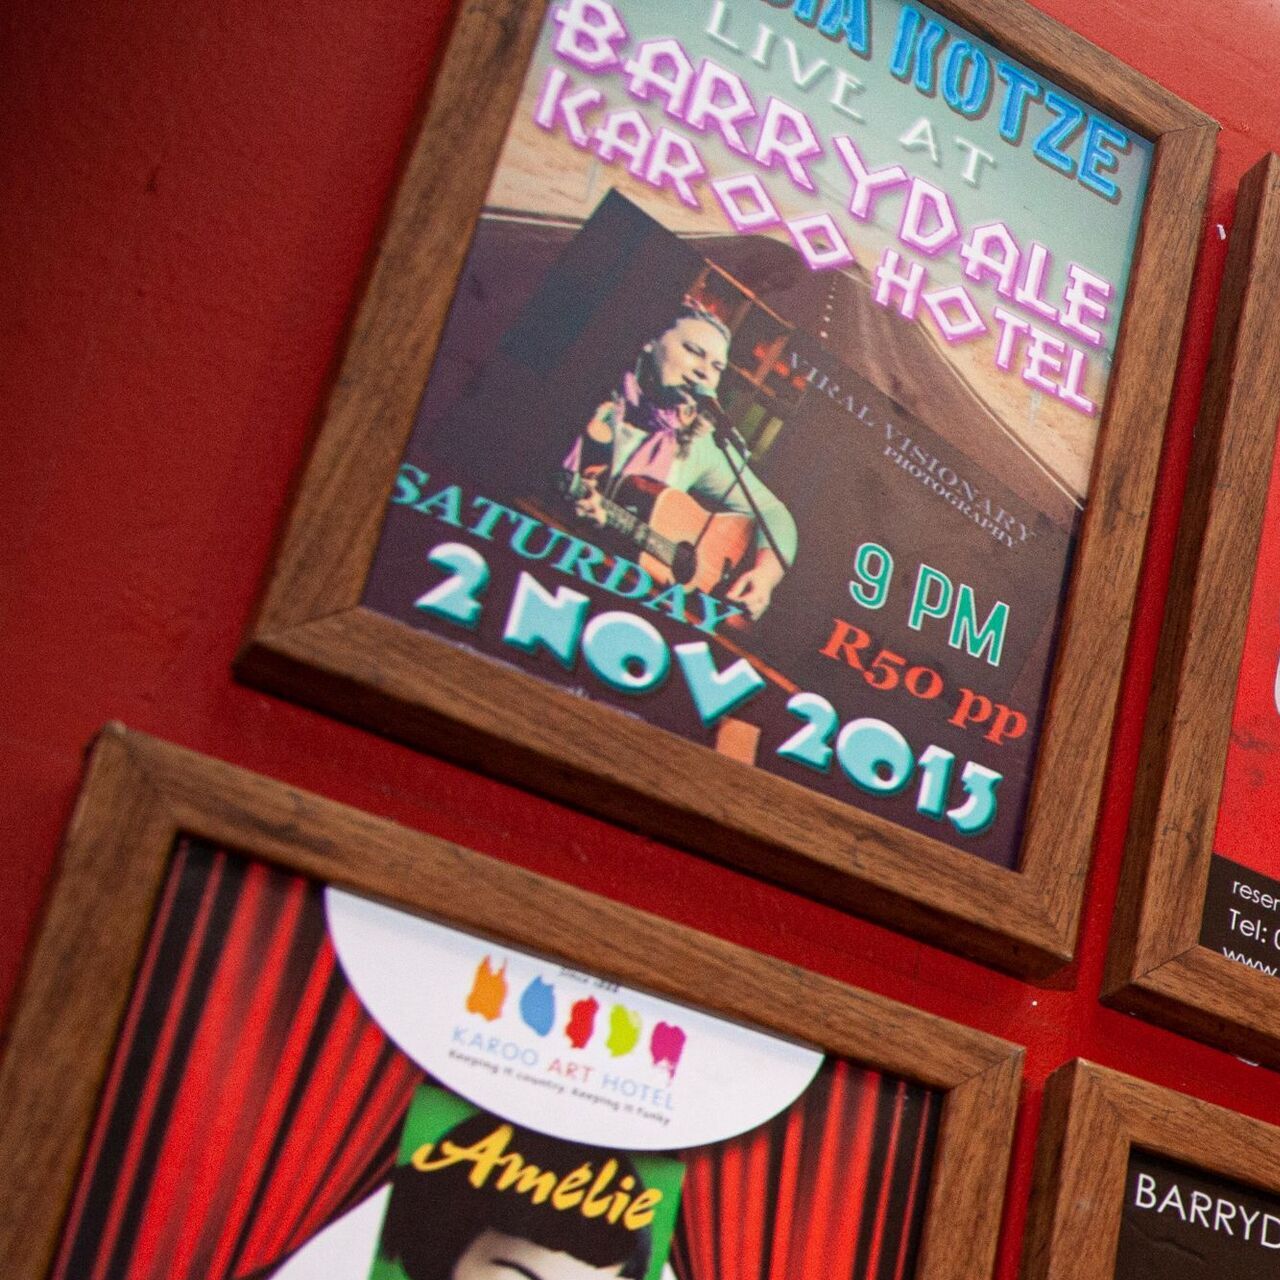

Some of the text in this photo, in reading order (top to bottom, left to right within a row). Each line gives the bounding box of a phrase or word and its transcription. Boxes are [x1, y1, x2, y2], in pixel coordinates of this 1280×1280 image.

[549, 0, 1117, 347] BARRYDALE
[705, 0, 867, 123] LIVE
[901, 116, 995, 186] AT
[891, 7, 1128, 199] KOTZE
[533, 67, 1099, 418] KAROO HOTEL
[780, 350, 1036, 545] VIRAL VISIONARY
[391, 463, 740, 635] SATURDAY
[848, 541, 1011, 668] 9 PM
[415, 541, 1008, 837] 2 NOV 2013
[818, 619, 1029, 745] R50 pp
[1228, 908, 1268, 945] Tel:
[452, 1025, 539, 1067] KAROO
[547, 1058, 595, 1083] ART
[601, 1074, 674, 1110] HOTEL
